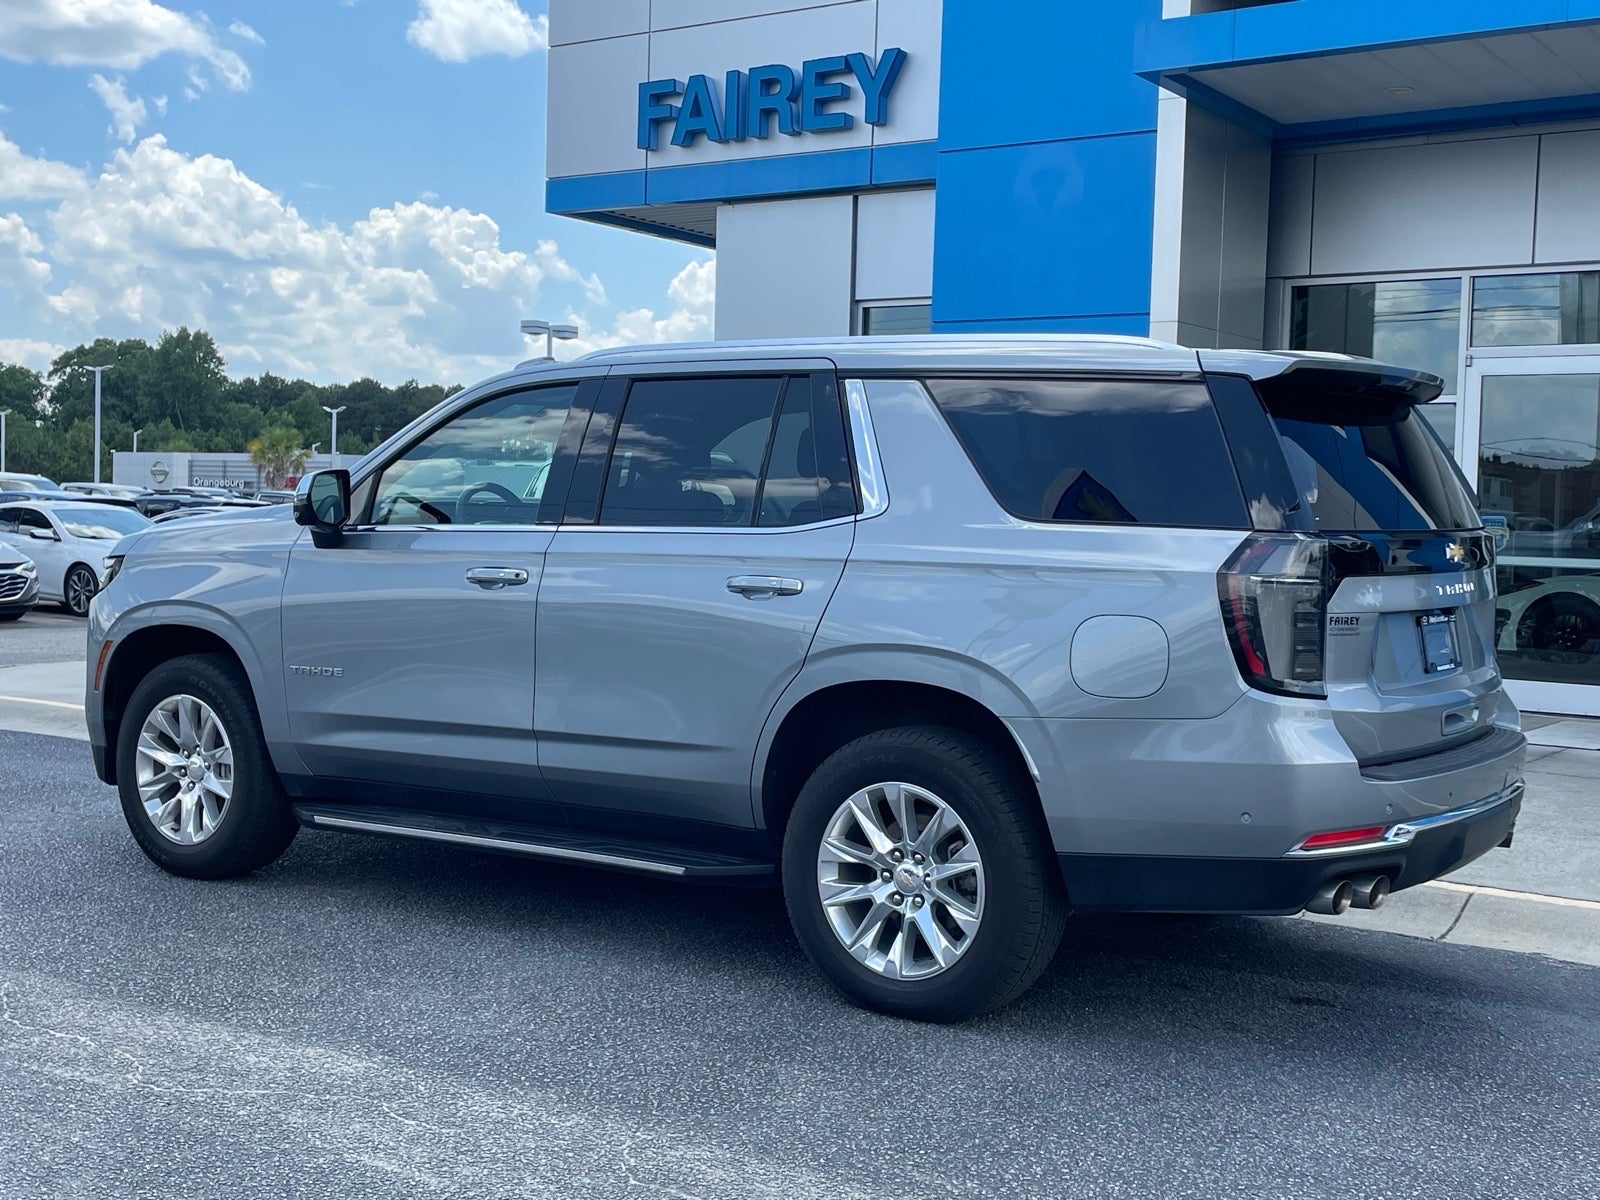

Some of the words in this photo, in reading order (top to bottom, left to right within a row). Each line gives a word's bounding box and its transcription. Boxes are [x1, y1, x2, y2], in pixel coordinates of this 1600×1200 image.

[638, 48, 908, 150] FAIREY
[193, 476, 245, 489] Orangeburg
[1329, 616, 1360, 626] FAIREY
[289, 665, 343, 676] TAHOE
